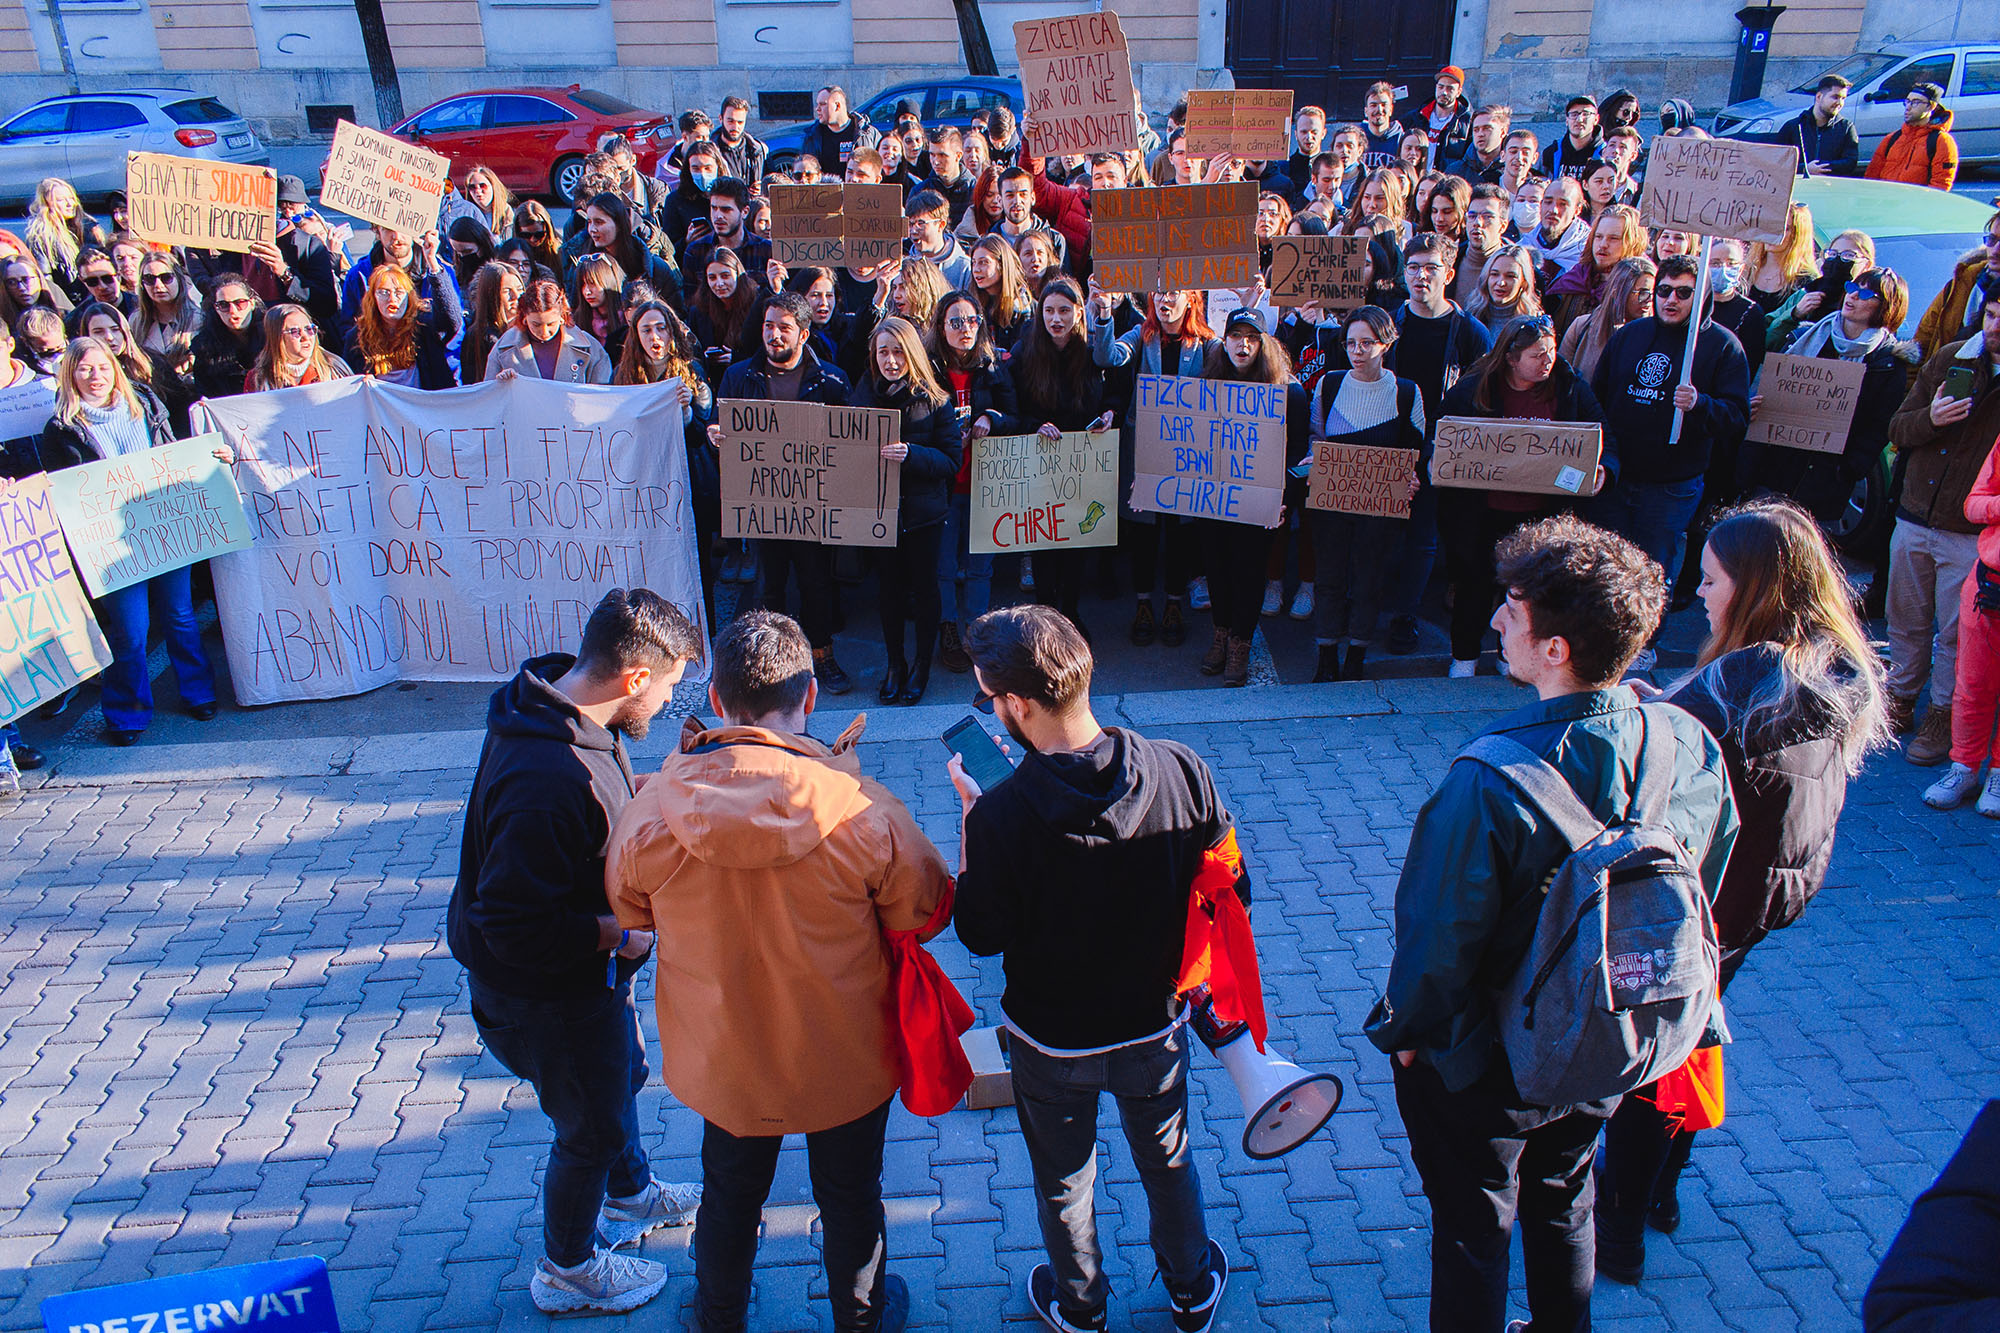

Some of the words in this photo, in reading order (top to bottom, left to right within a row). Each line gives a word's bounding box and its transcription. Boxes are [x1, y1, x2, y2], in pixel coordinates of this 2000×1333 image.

[1754, 33, 1765, 46] P
[1030, 87, 1053, 113] DAR
[1061, 83, 1082, 106] VOI
[1093, 79, 1118, 105] NE
[335, 146, 345, 162] A
[347, 151, 378, 175] SUNAT
[354, 133, 395, 159] DOMNULE
[1664, 162, 1687, 178] SE
[361, 175, 381, 193] CAM
[389, 186, 412, 206] VREA
[857, 197, 881, 210] SAU
[1096, 193, 1122, 219] NOI
[1205, 184, 1236, 214] NU
[132, 198, 156, 232] NU
[163, 201, 201, 237] VREM
[1652, 186, 1694, 225] NU
[1169, 221, 1193, 252] DE
[1303, 238, 1335, 256] LUNI
[1342, 238, 1359, 255] DE
[1165, 259, 1193, 288] NU
[1201, 255, 1249, 284] AVEM
[1272, 241, 1301, 297] 2
[1326, 269, 1335, 283] 2
[1291, 281, 1306, 295] DE
[1791, 363, 1834, 383] WOULD
[1138, 375, 1193, 410] FIZIC
[1777, 379, 1821, 397] PREFER
[1826, 384, 1855, 400] NOT
[1815, 399, 1831, 411] TO
[1073, 432, 1094, 453] LA
[1160, 414, 1195, 444] DAR
[282, 429, 341, 480] NE
[740, 441, 766, 462] DE
[1039, 454, 1064, 476] DAR
[1069, 452, 1087, 473] NU
[1095, 450, 1113, 473] NE
[1319, 446, 1414, 469] BULVERSAREA
[1449, 448, 1464, 460] DE
[77, 471, 94, 497] 2
[106, 464, 136, 488] ANI
[151, 450, 174, 476] DE
[1230, 454, 1255, 481] DE
[80, 465, 205, 520] DEZVOLTARE
[750, 466, 829, 502] APROAPE
[124, 510, 136, 531] O
[464, 485, 487, 532] E
[275, 543, 343, 587] VOI
[368, 538, 452, 578] DOAR
[250, 594, 468, 687] ABANDONUL
[67, 1285, 312, 1333] EZERVAT
